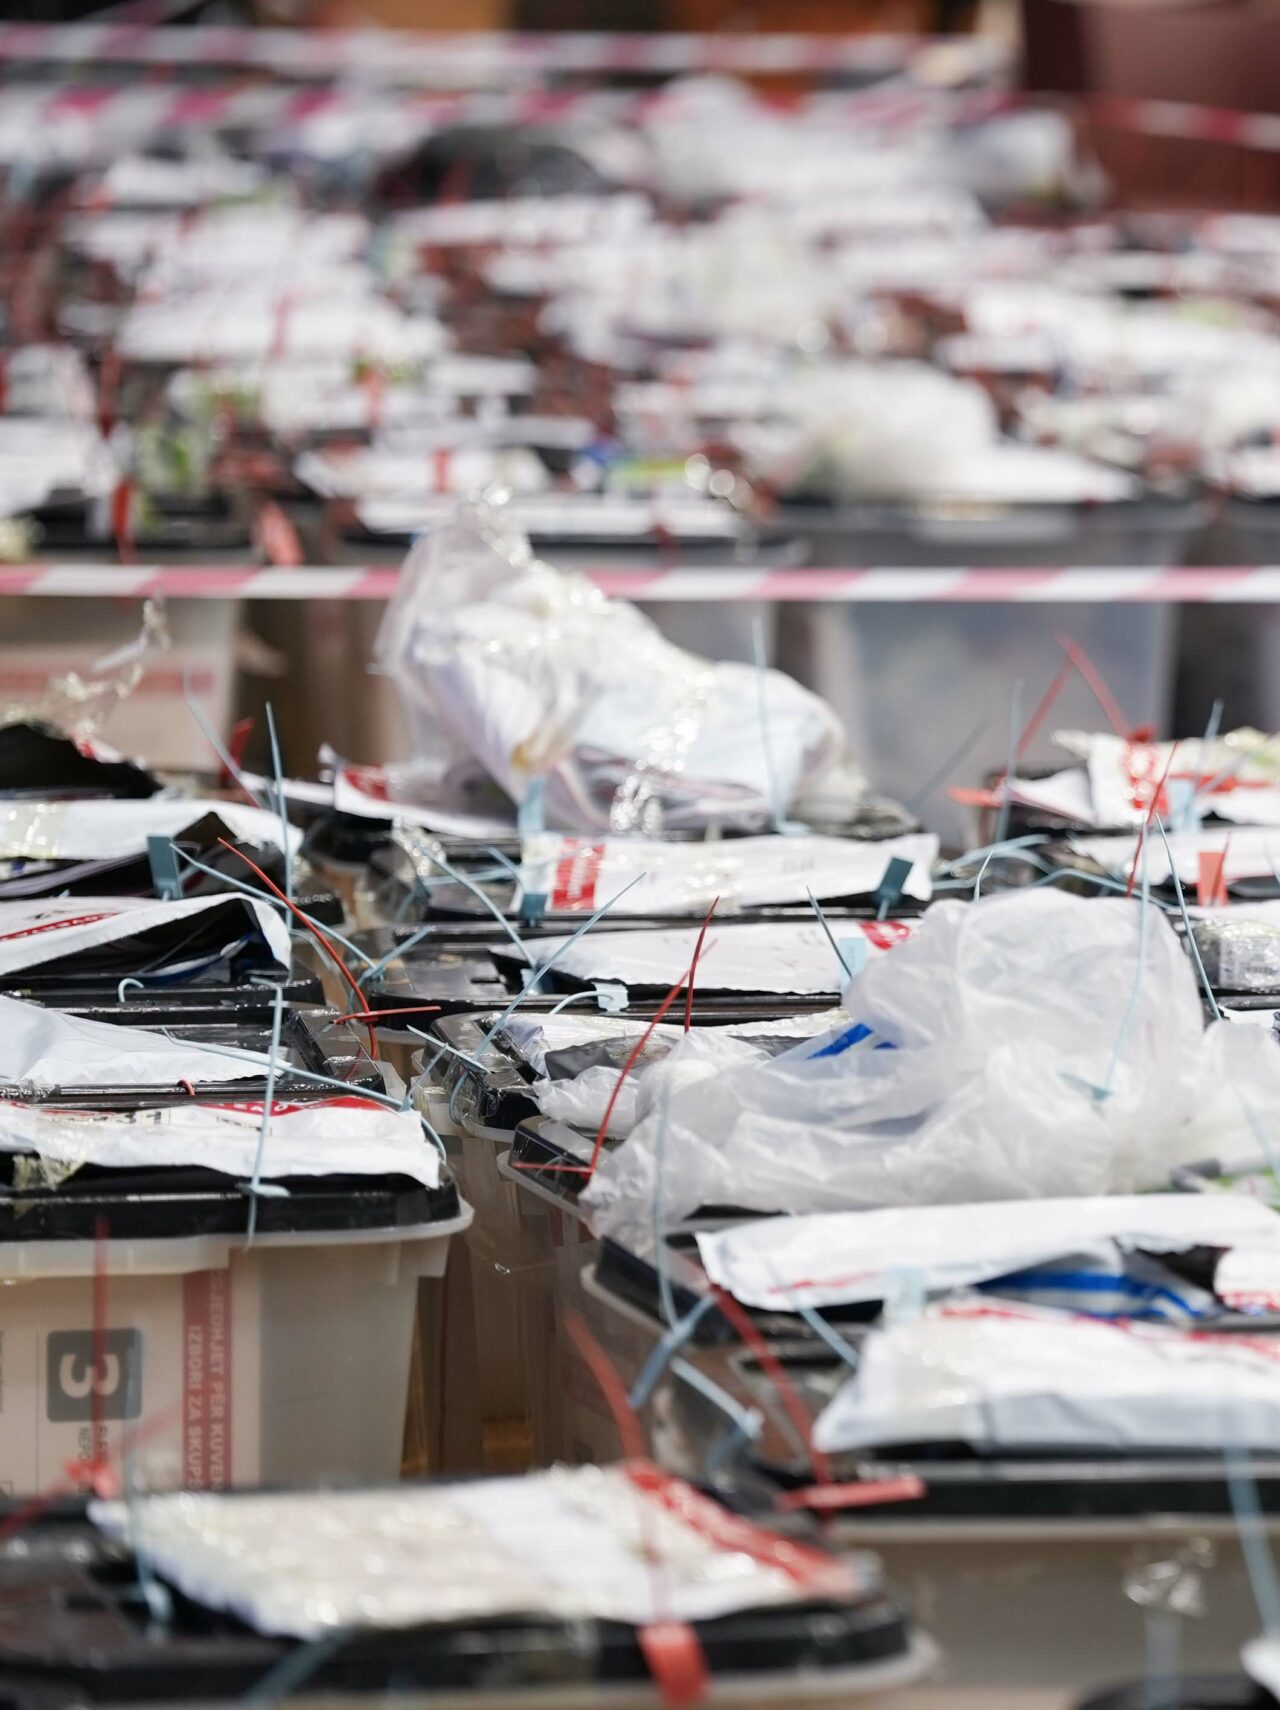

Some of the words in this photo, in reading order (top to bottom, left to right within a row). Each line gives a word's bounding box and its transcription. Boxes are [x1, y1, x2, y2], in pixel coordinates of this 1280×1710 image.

[59, 1353, 120, 1398] 3
[188, 1325, 202, 1389] IZBORI
[188, 1396, 202, 1419] ZA
